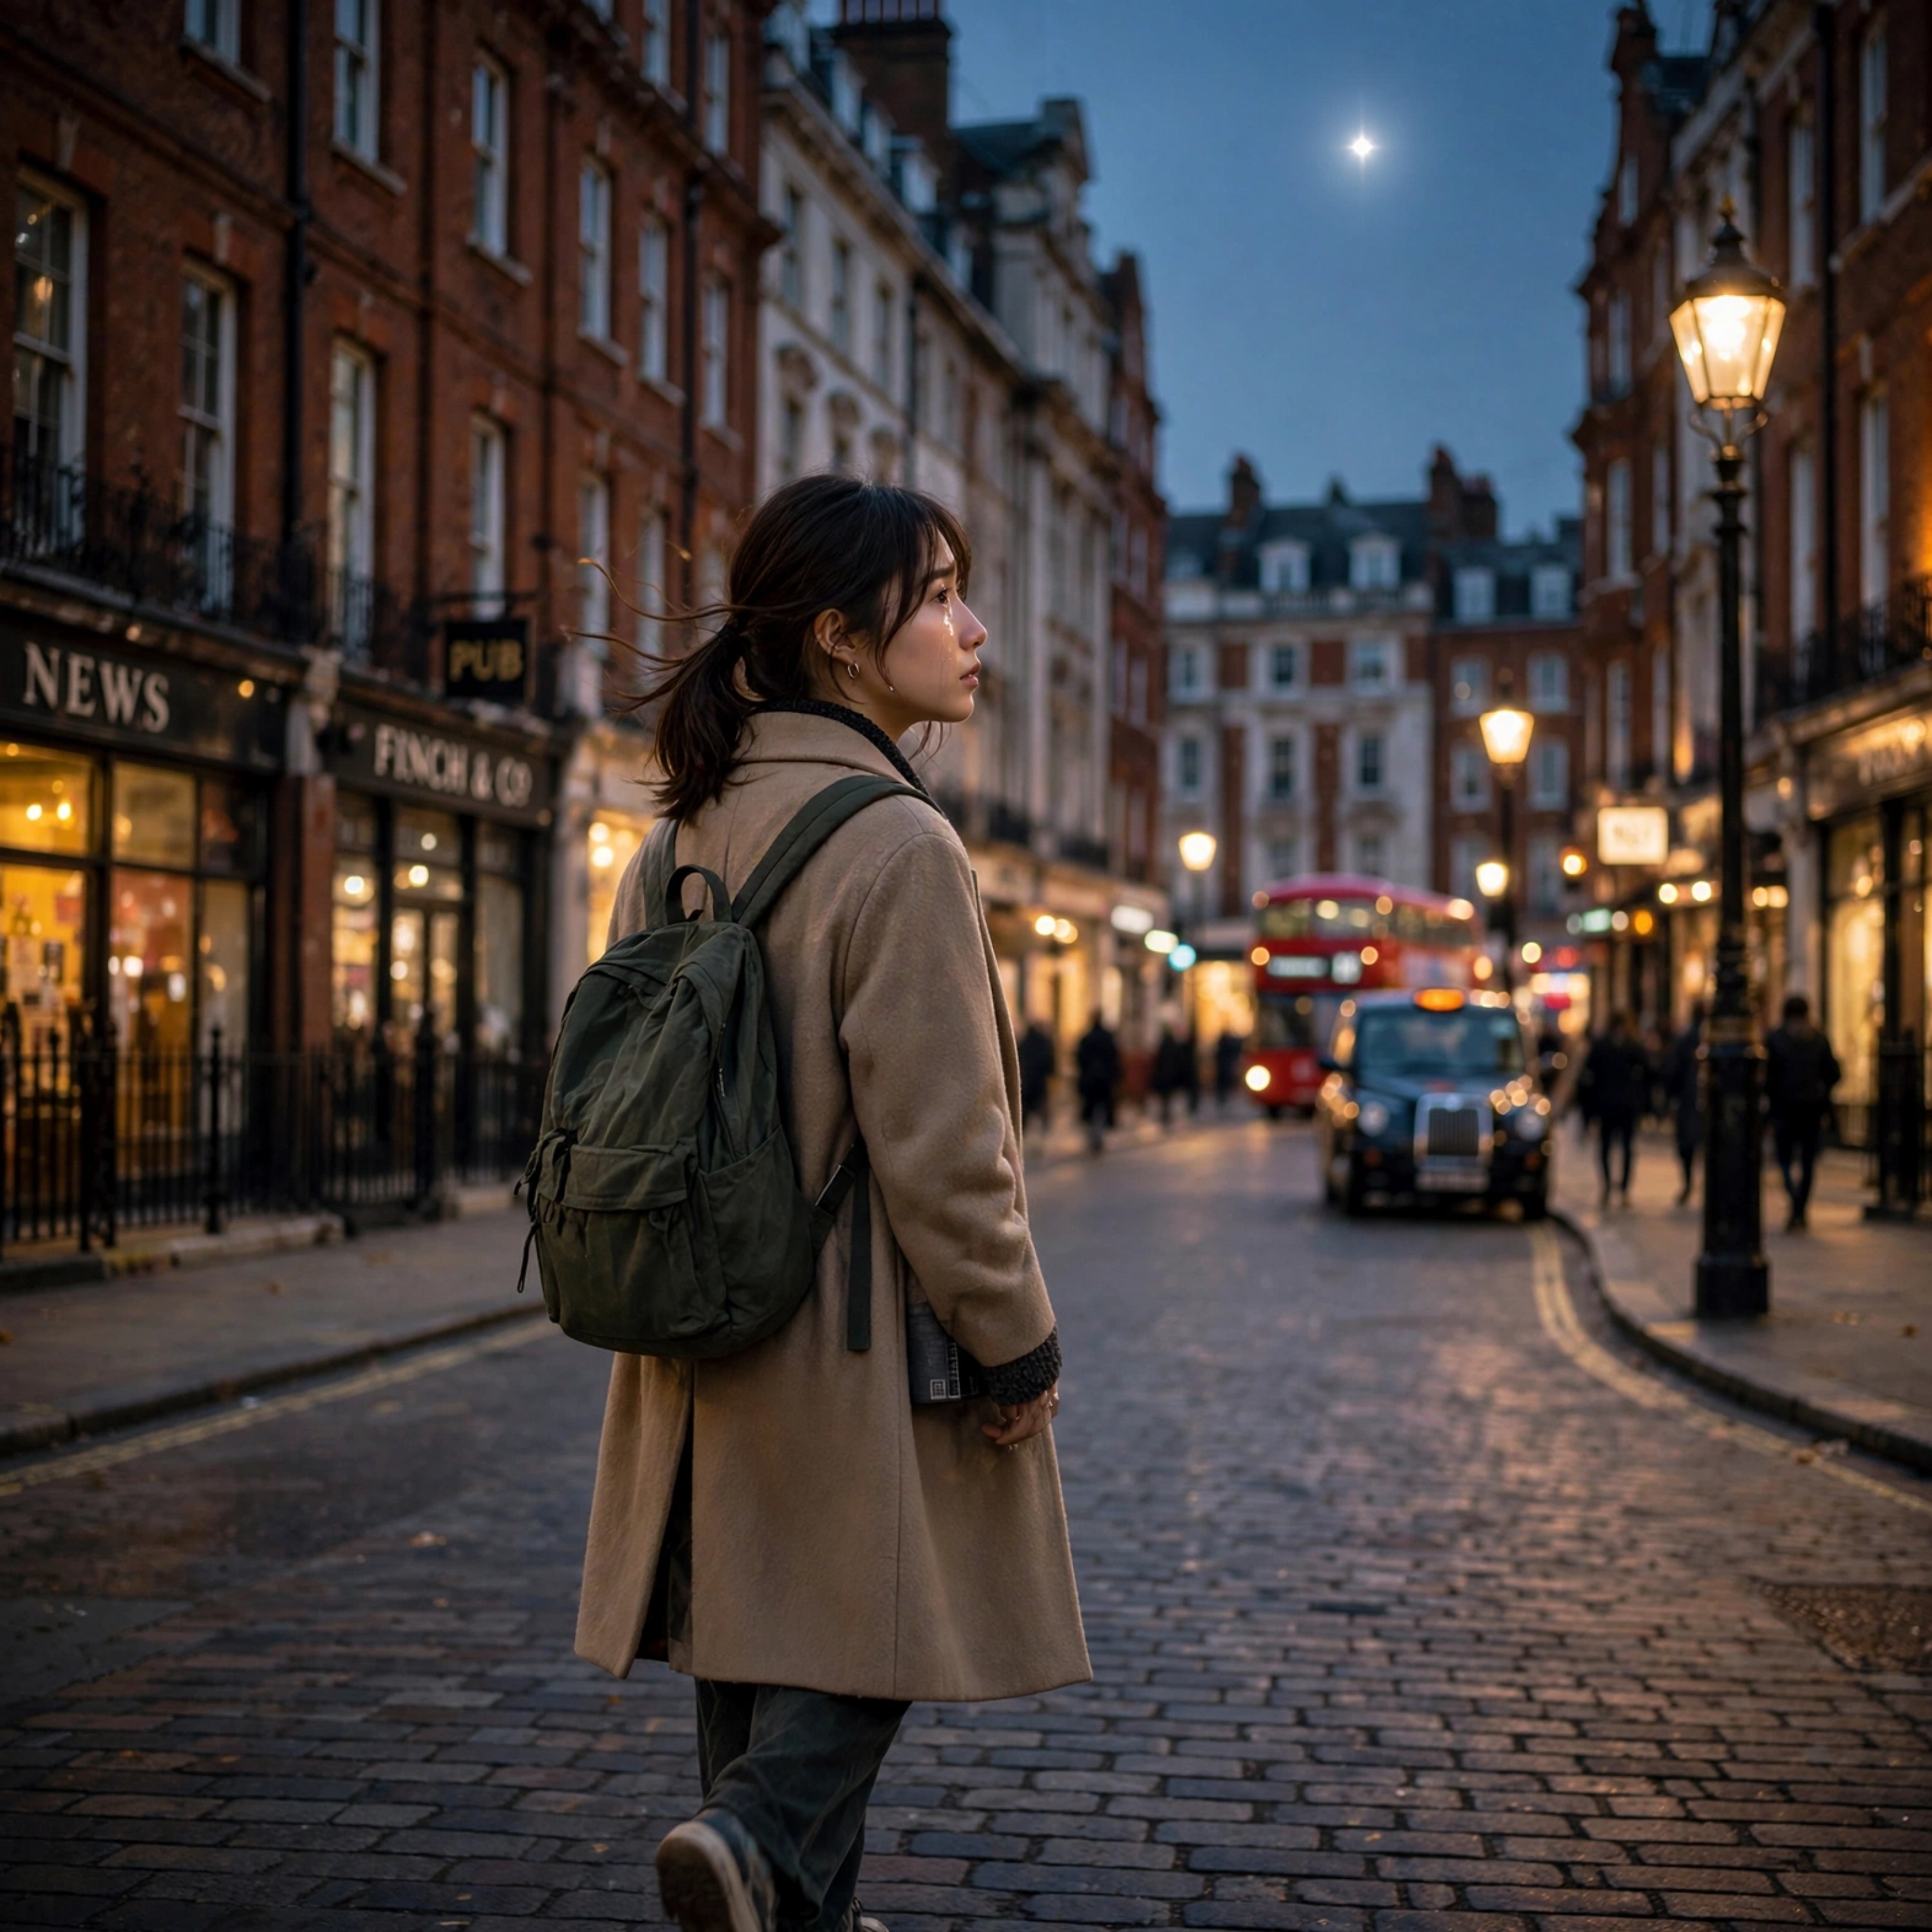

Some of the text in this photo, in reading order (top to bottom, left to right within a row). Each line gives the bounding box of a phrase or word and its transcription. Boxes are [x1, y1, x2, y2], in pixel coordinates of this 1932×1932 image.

[451, 639, 522, 681] PUB
[24, 642, 170, 733] NEWS
[471, 752, 493, 800] &
